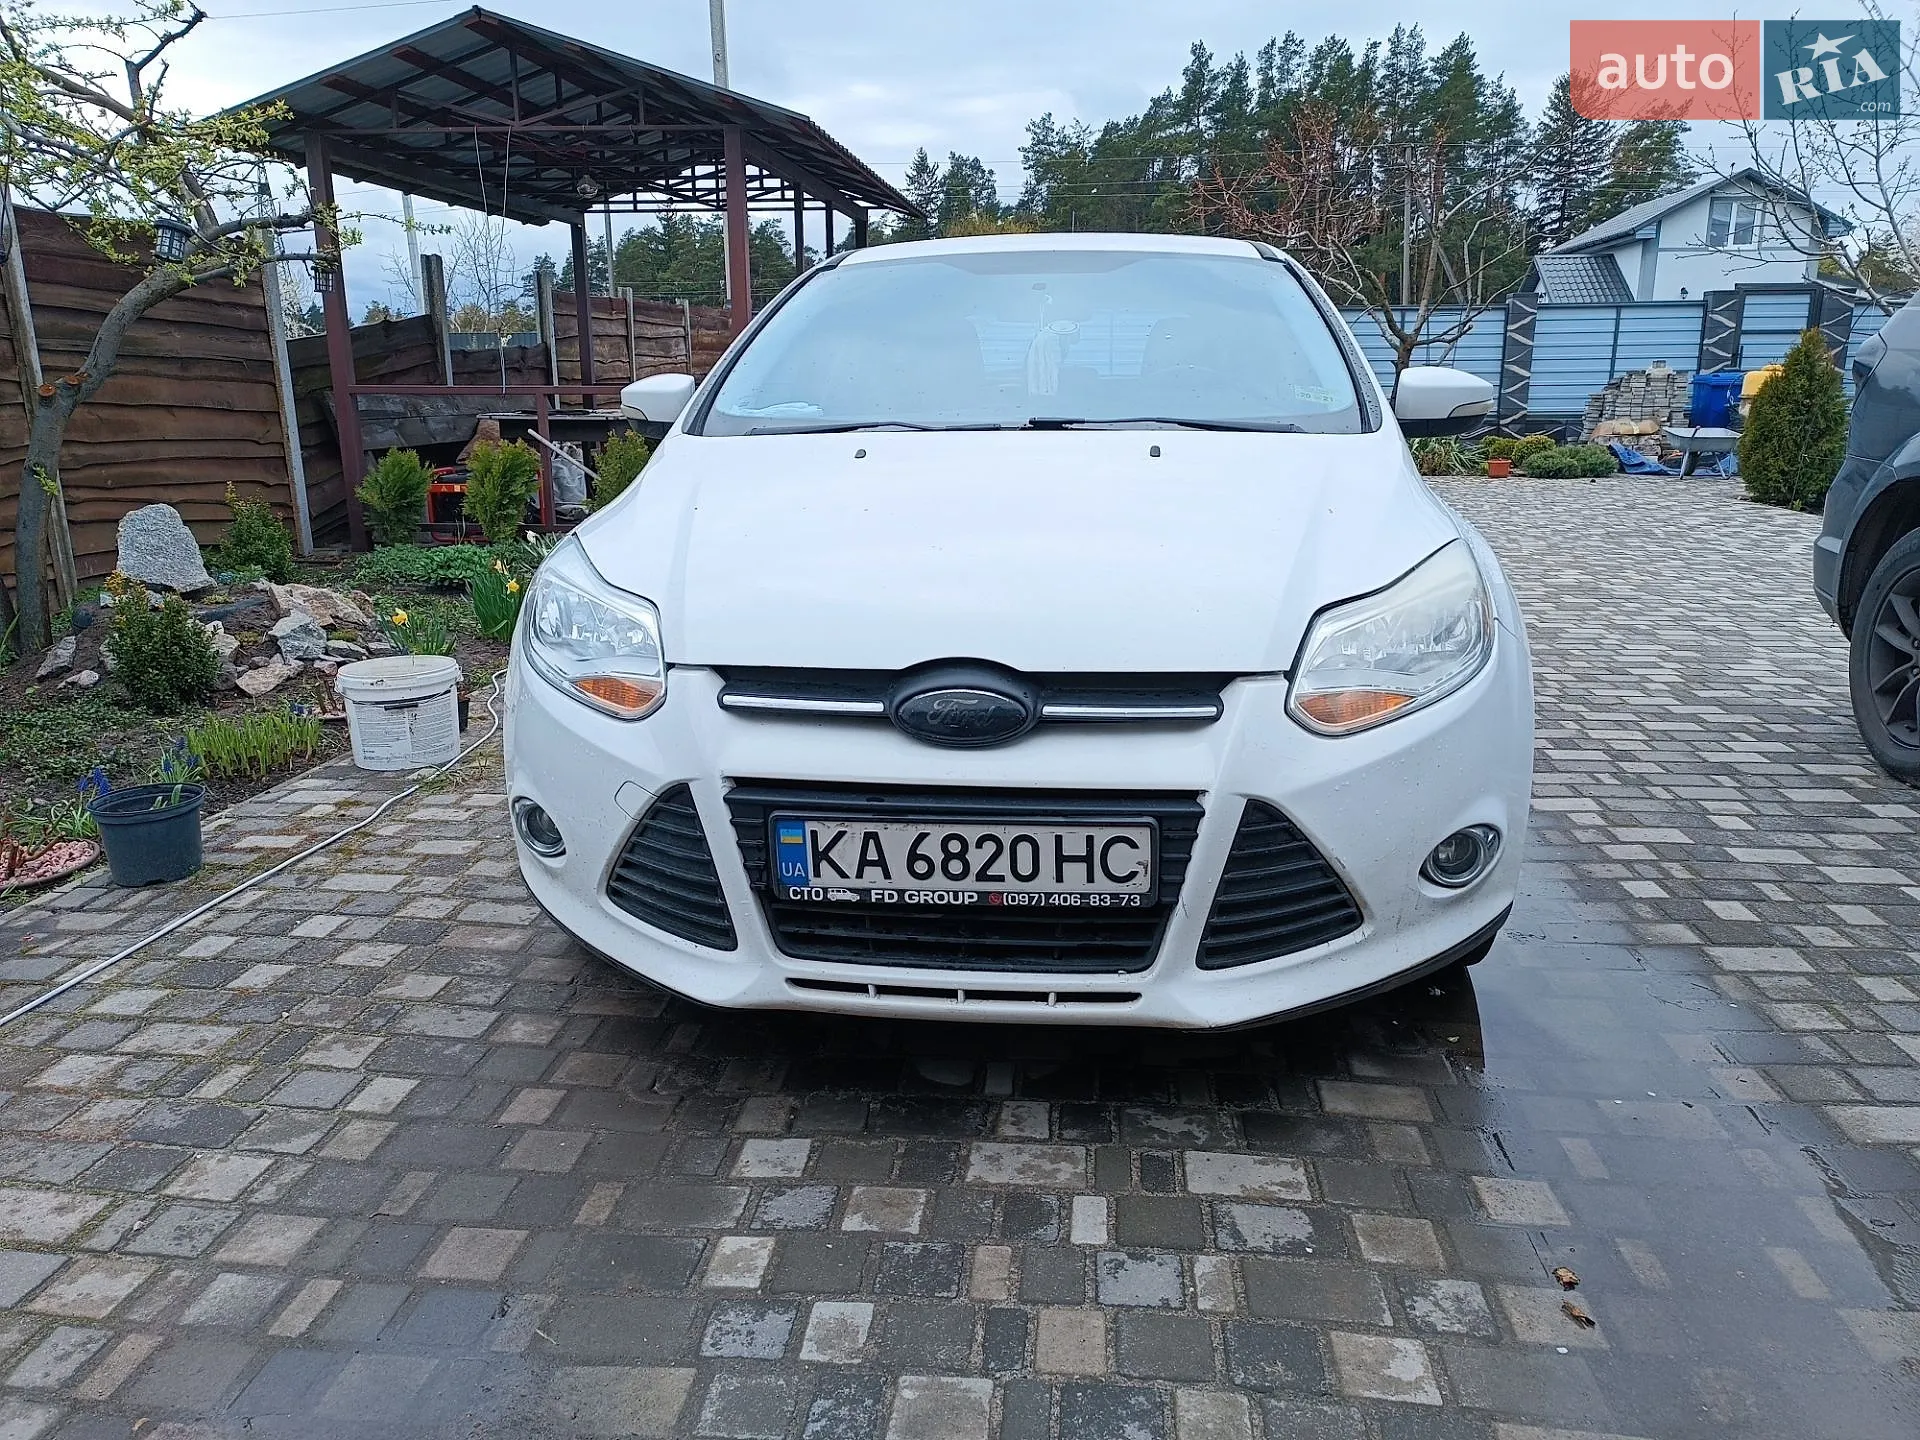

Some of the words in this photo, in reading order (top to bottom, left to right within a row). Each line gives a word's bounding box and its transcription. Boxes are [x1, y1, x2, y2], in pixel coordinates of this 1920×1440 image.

[926, 698, 995, 728] Ford
[810, 829, 893, 880] KA
[906, 832, 1040, 883] 6820
[1054, 834, 1141, 884] HC
[782, 862, 806, 877] UA
[870, 889, 898, 903] FD
[904, 890, 978, 905] GROUP
[1002, 891, 1045, 907] (097)
[1048, 893, 1141, 907] 406-83-73
